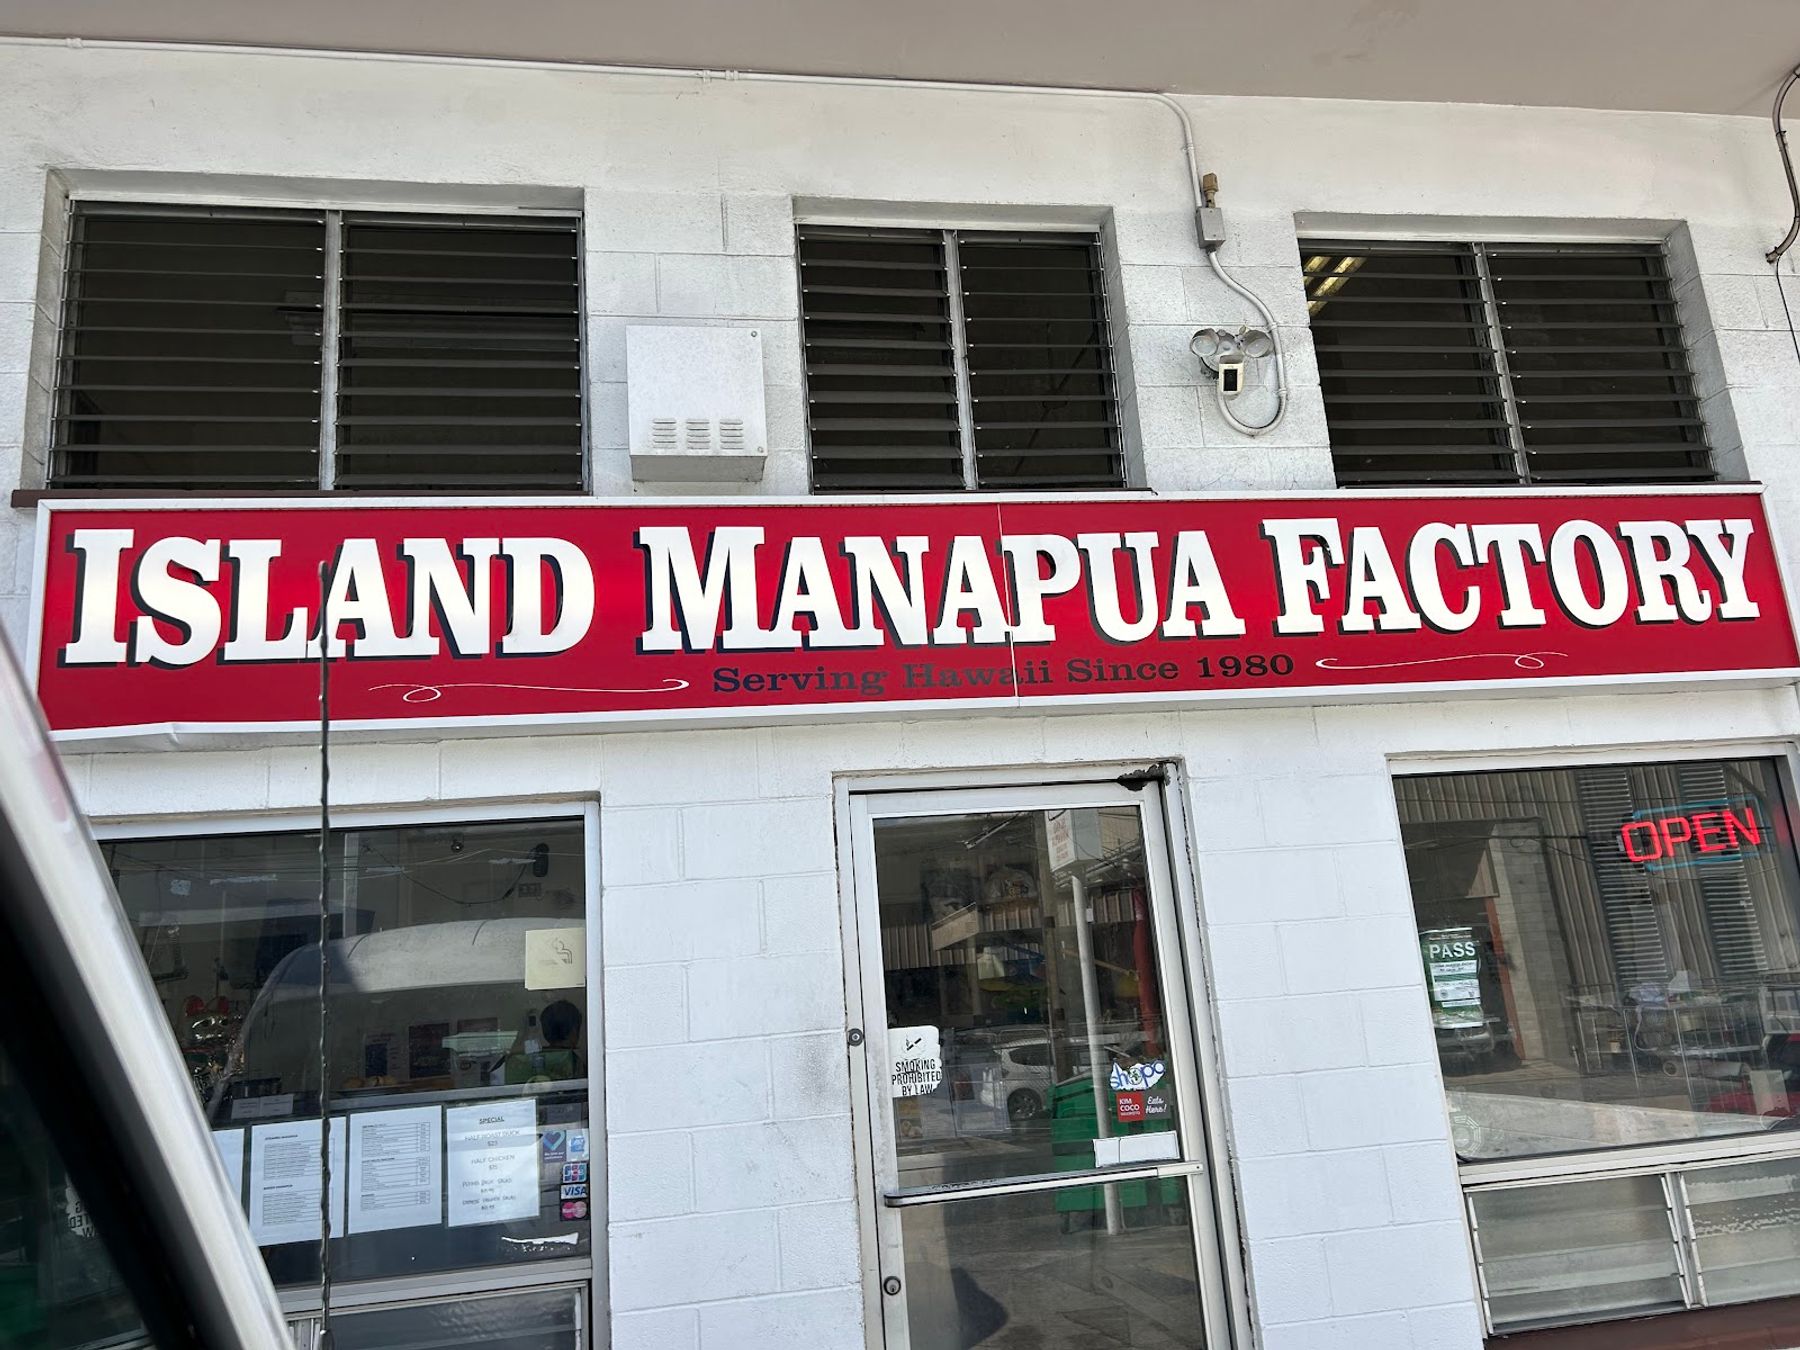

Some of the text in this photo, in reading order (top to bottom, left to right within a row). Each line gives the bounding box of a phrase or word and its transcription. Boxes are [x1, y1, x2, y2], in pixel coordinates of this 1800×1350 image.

[60, 517, 1761, 668] ISLAND MANAPUA FACTORY
[712, 653, 1295, 696] Serving Hawaii Since 1980
[1620, 806, 1762, 863] OPEN
[1429, 941, 1476, 959] PASS
[895, 1058, 936, 1072] SMOKING
[891, 1071, 942, 1085] PROHIBITED
[902, 1083, 933, 1096] BY LAW
[1120, 1104, 1140, 1112] COCO
[479, 1116, 505, 1124] SPECIAL
[564, 1186, 588, 1197] VISA
